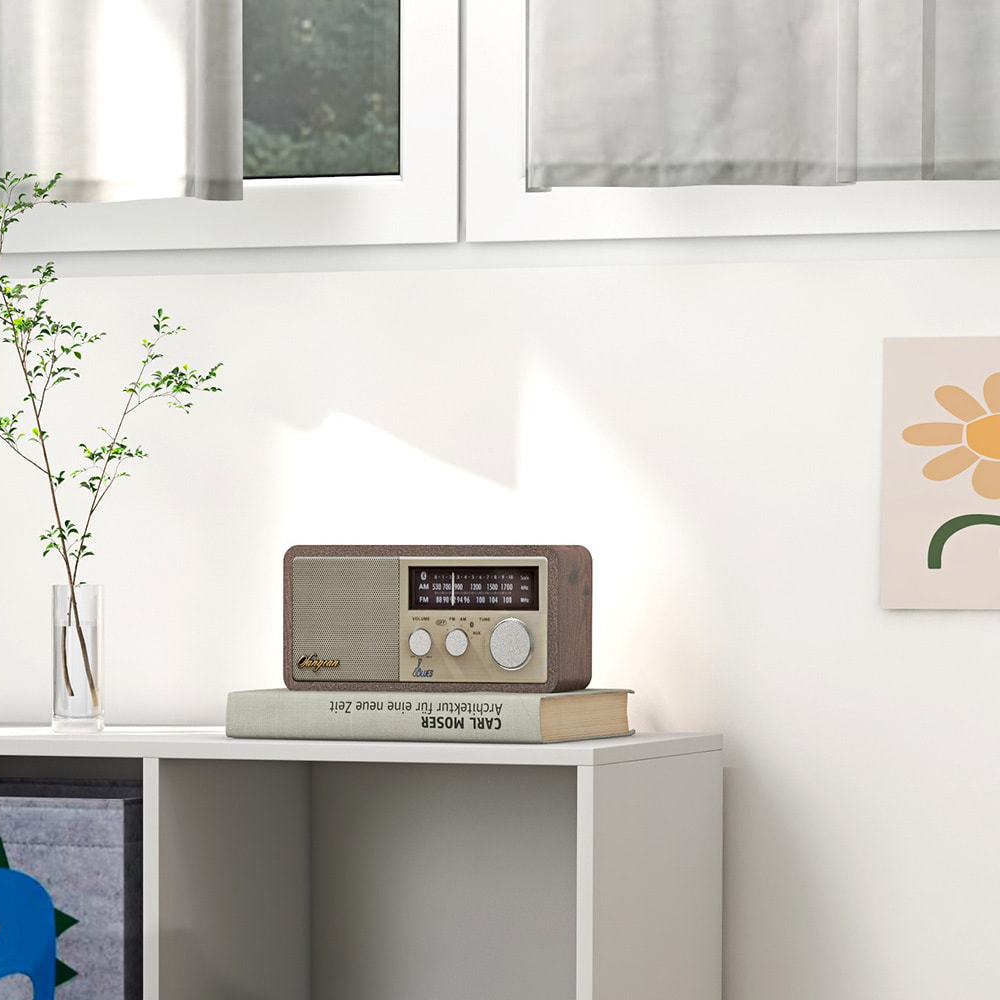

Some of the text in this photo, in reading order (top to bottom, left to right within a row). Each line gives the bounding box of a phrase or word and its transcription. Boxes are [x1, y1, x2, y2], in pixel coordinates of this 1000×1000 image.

[432, 583, 442, 591] 530
[442, 583, 452, 591] 700
[454, 583, 463, 591] 900
[470, 583, 482, 591] 1200
[487, 583, 498, 591] 1500
[501, 583, 513, 591] 1700
[436, 596, 443, 604] 88
[443, 596, 449, 604] 90
[457, 596, 463, 604] 94
[463, 596, 470, 604] 96
[476, 596, 486, 604] 100
[489, 596, 498, 604] 104
[503, 596, 512, 604] 108
[330, 700, 503, 715] Architektur für eine neue Zeit
[421, 716, 502, 730] CARL MOSER
